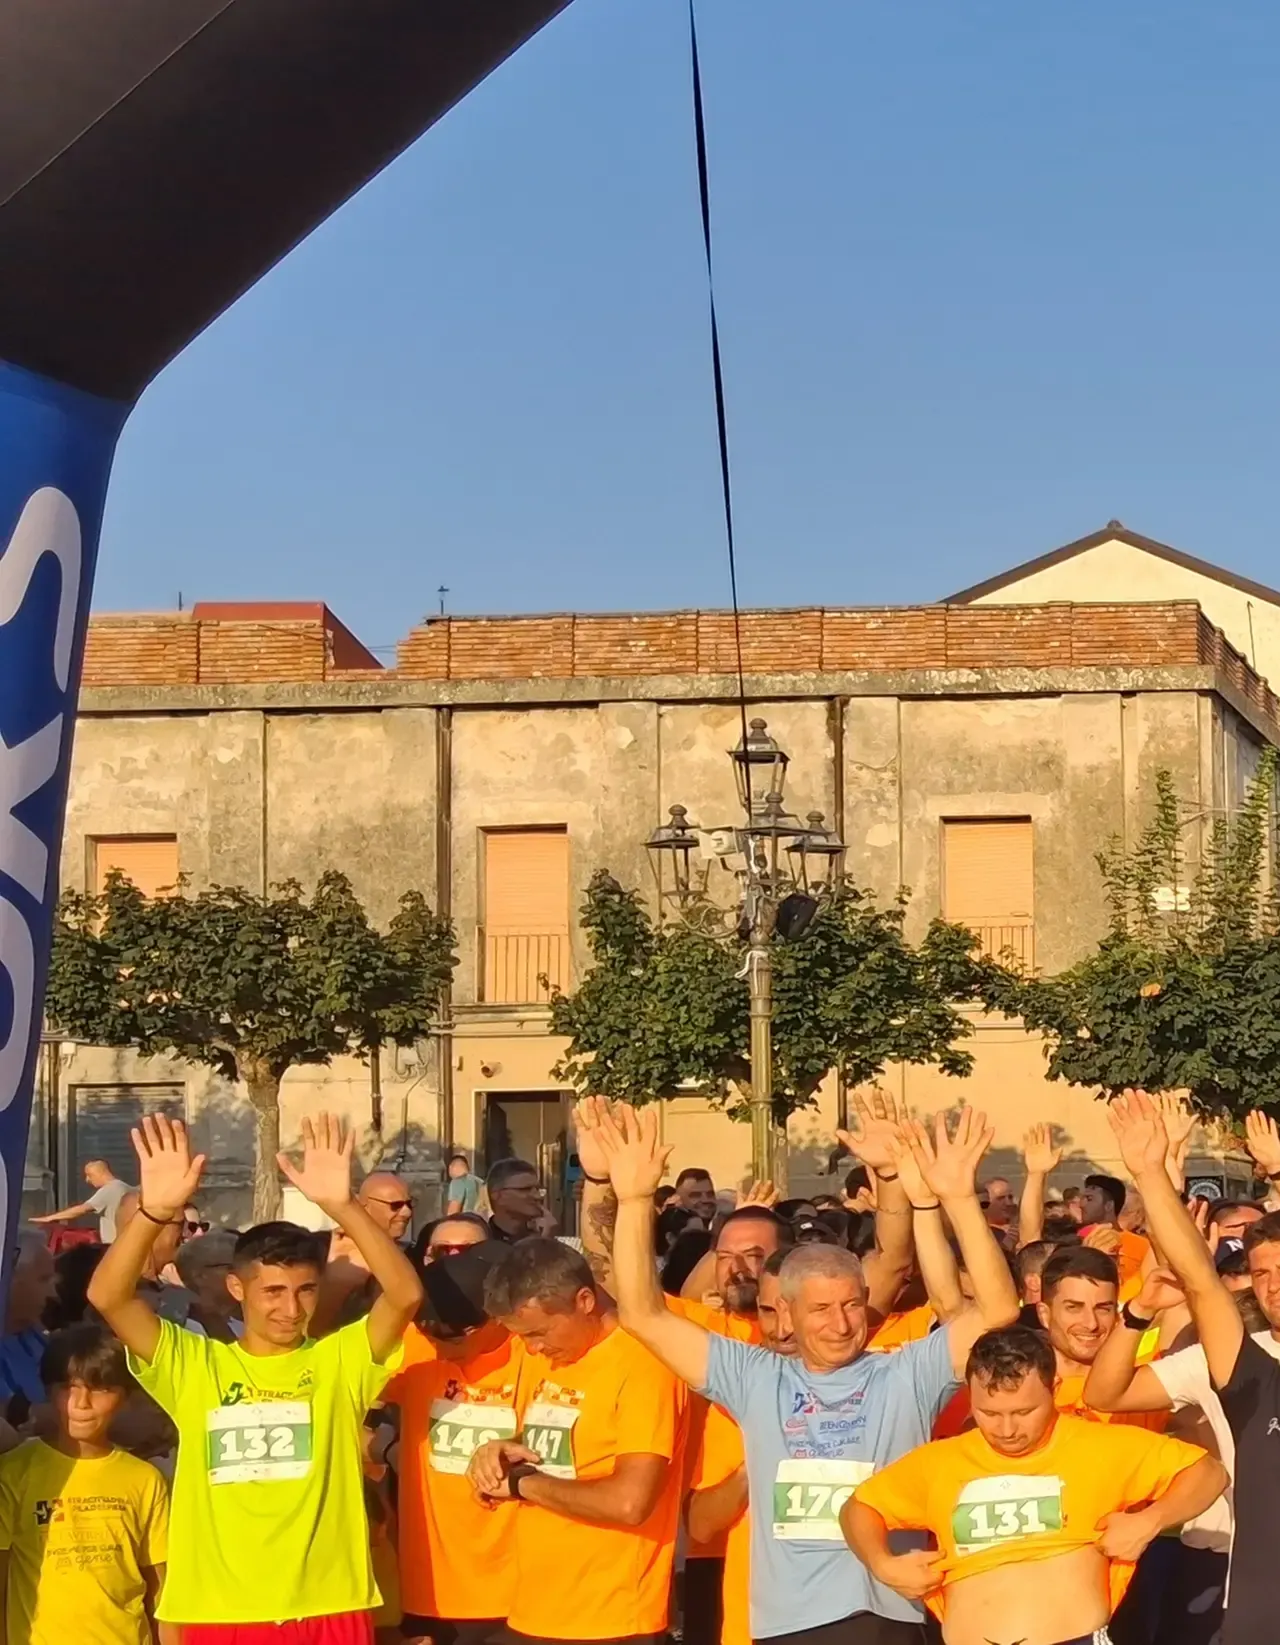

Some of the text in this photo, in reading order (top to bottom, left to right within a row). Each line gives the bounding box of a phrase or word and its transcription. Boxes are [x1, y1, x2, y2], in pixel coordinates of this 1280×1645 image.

[220, 1426, 295, 1461] 132
[527, 1428, 563, 1458] 147
[968, 1499, 1047, 1538] 131
